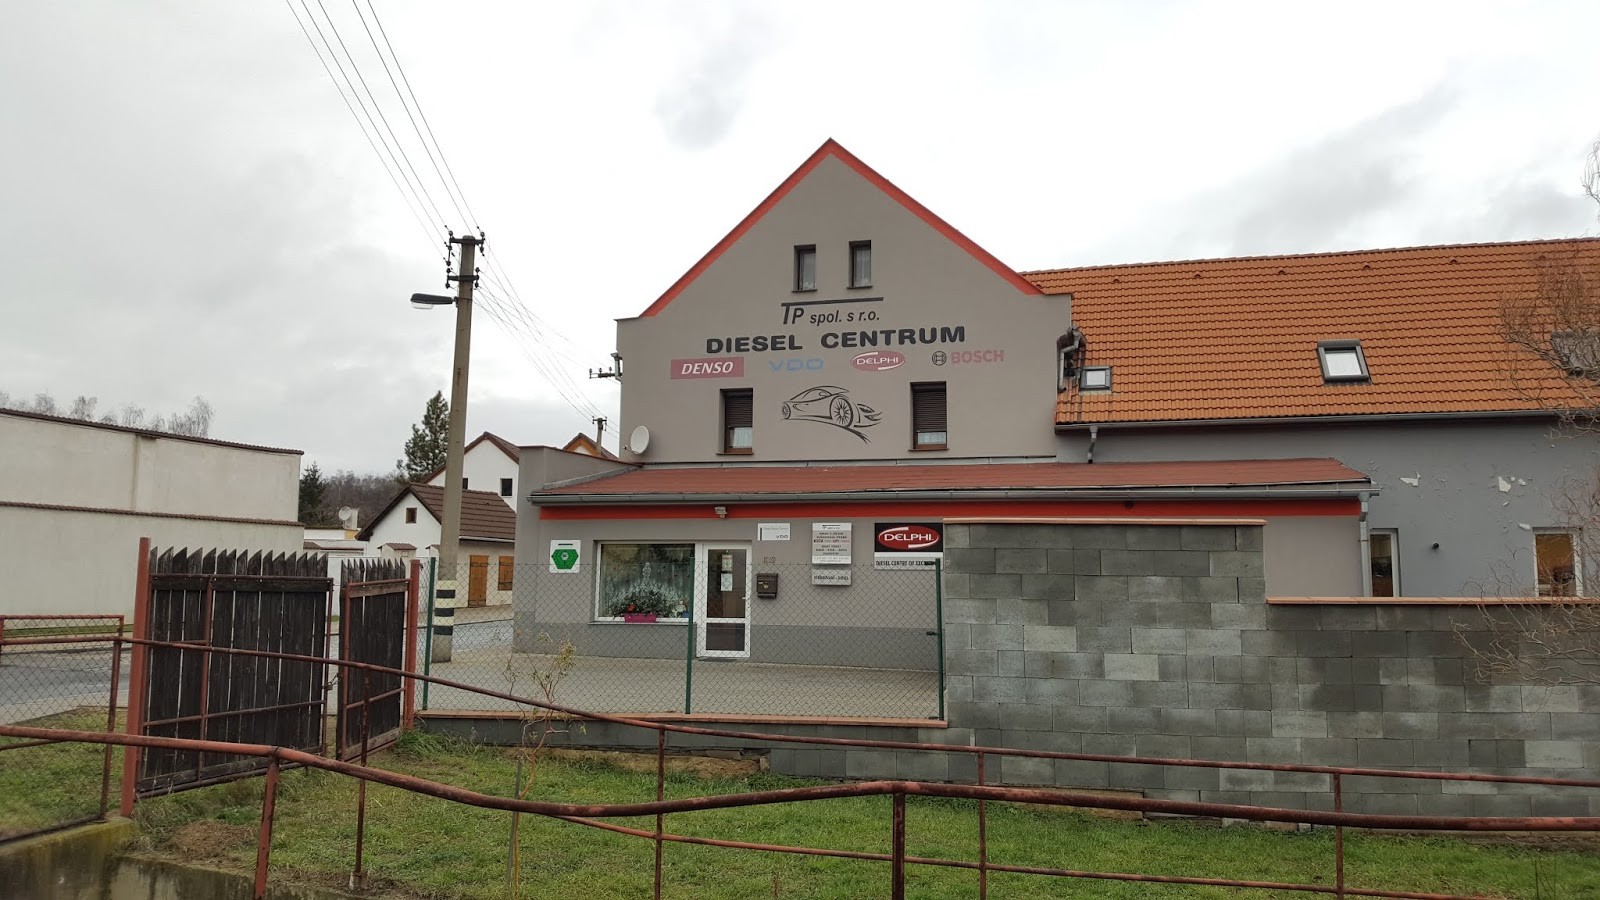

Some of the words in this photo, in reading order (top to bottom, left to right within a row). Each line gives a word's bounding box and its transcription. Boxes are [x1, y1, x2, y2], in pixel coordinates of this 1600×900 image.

[809, 310, 842, 327] spol.
[847, 312, 854, 322] s
[858, 310, 880, 321] r.o.
[706, 334, 803, 354] DIESEL
[820, 326, 965, 349] CENTRUM
[856, 356, 899, 365] DELPHI
[951, 350, 1005, 364] BOSCH
[681, 361, 734, 375] DENSO
[768, 357, 825, 373] VDO
[884, 533, 932, 541] DELPHI
